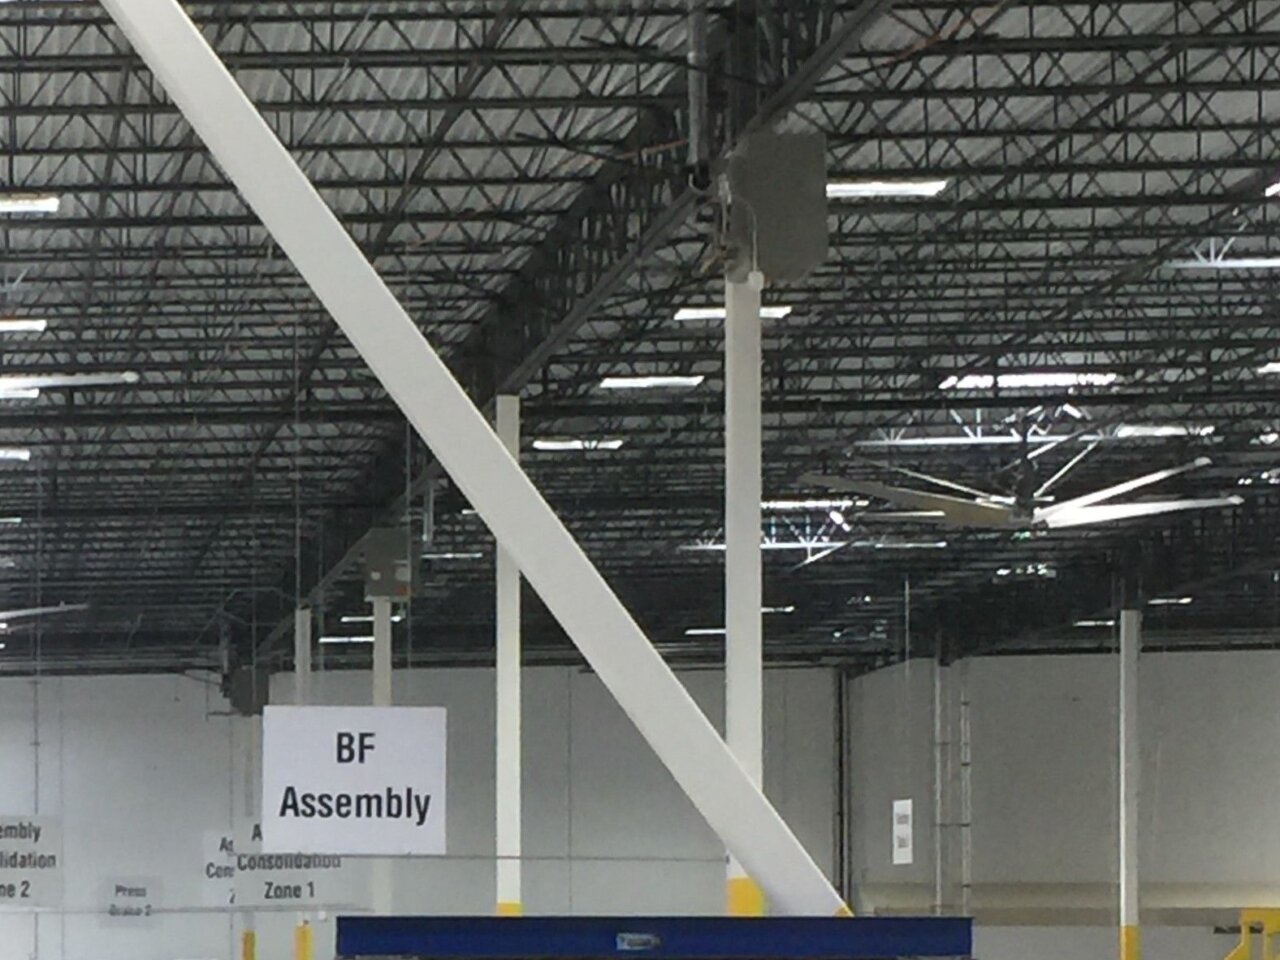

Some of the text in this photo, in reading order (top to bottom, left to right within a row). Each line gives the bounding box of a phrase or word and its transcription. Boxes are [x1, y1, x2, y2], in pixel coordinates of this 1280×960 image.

[336, 732, 376, 763] BF
[279, 786, 431, 826] Assembly
[20, 880, 31, 898] 2
[264, 881, 315, 900] Zone 1
